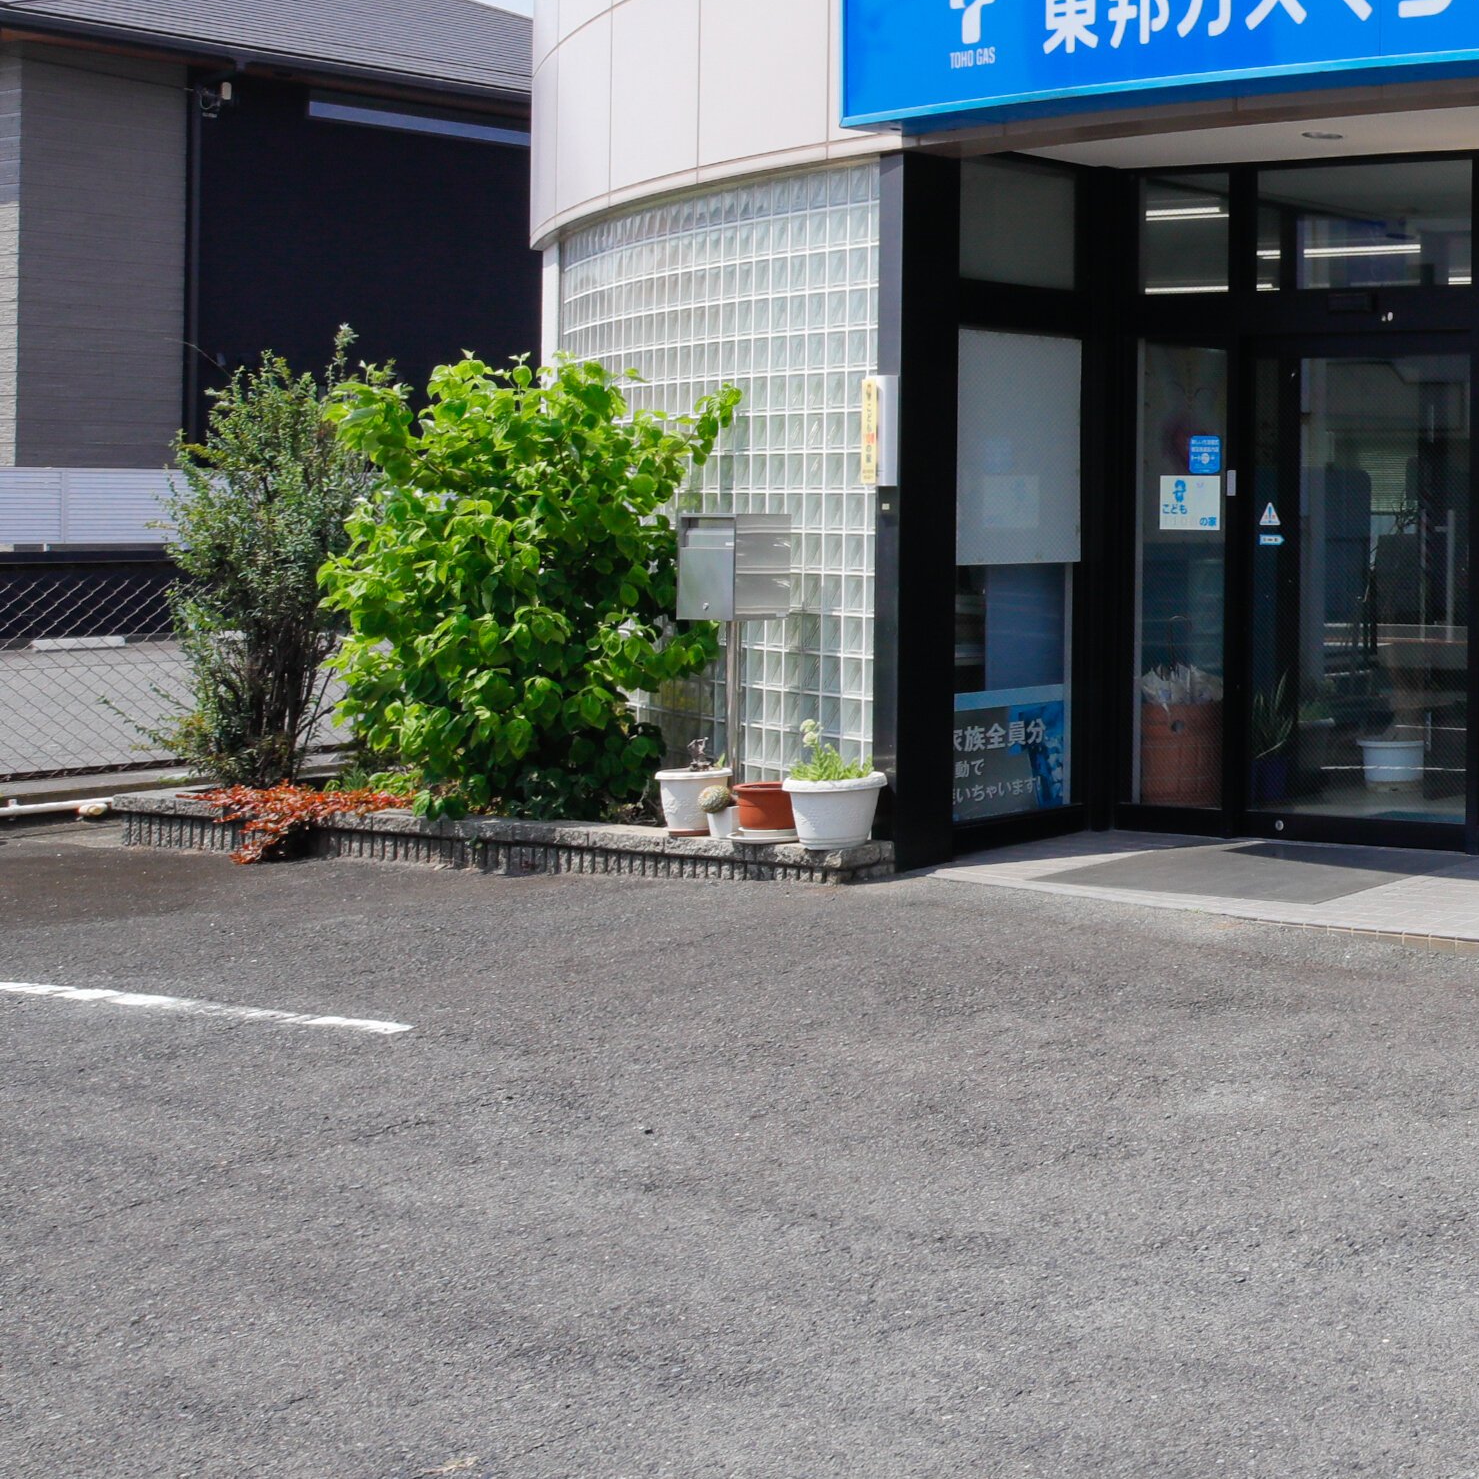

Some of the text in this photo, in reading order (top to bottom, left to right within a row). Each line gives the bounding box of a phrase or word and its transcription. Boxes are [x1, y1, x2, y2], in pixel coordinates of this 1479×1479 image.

[949, 46, 996, 70] TOHO GAS
[1162, 503, 1188, 515] こども
[952, 776, 1041, 806] いちゃいます!
